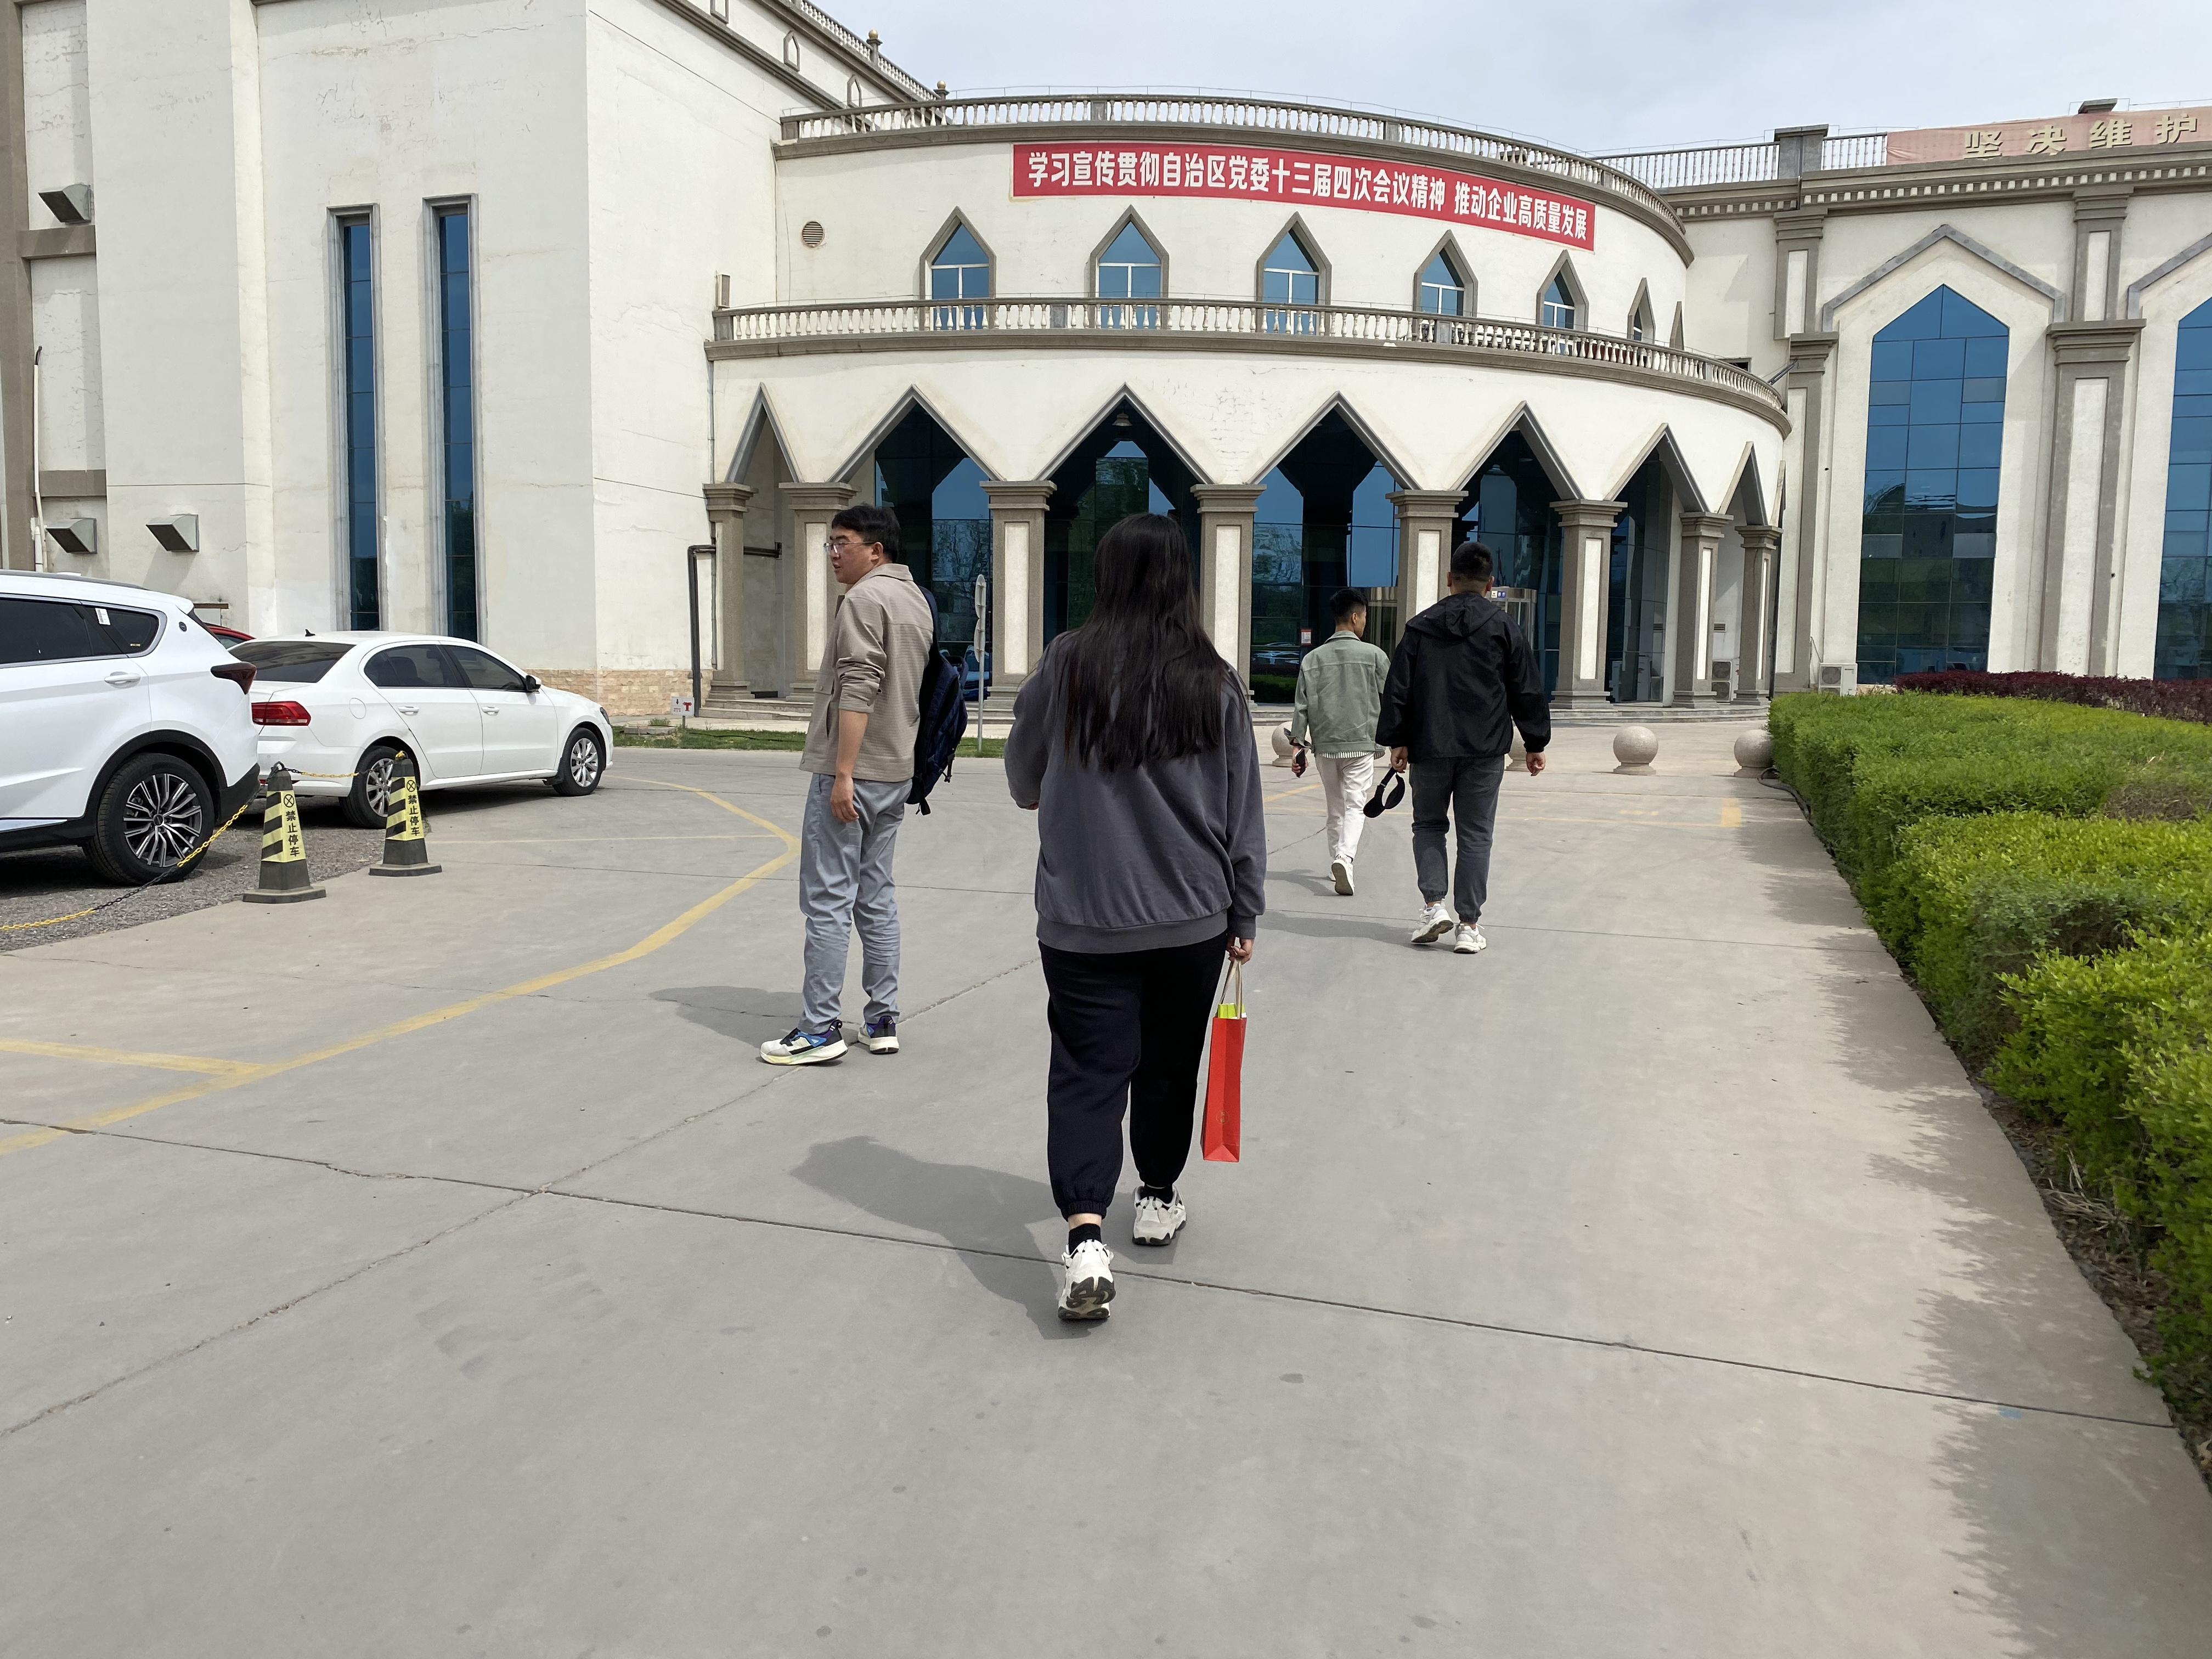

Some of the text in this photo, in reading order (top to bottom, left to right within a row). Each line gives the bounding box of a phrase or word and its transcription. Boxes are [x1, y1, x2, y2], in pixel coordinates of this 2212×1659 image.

[1963, 113, 2198, 161] 坚决维护
[1028, 150, 1588, 241] 学习宣传贯彻自治区党委十三届四次会议精神 推动企业高质量发展
[285, 810, 300, 856] 禁止停车
[408, 794, 420, 836] 禁止停车
